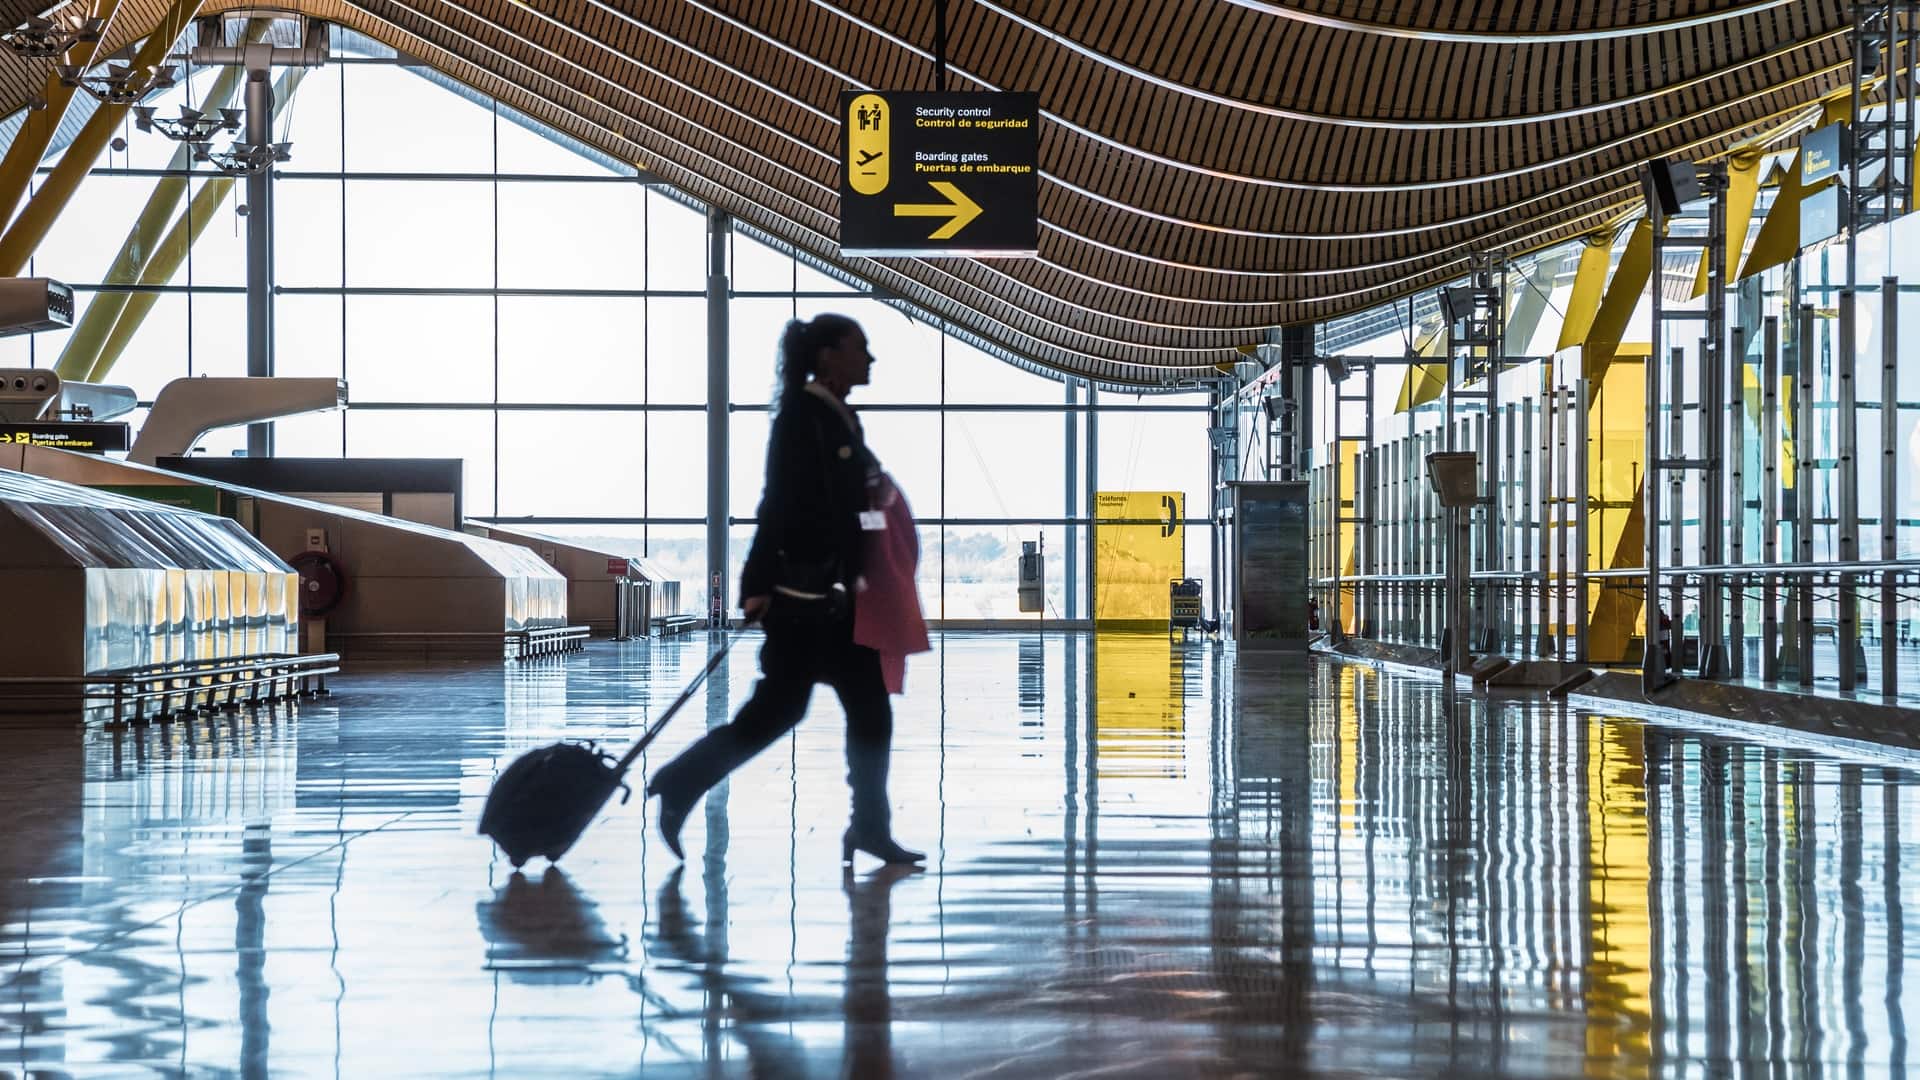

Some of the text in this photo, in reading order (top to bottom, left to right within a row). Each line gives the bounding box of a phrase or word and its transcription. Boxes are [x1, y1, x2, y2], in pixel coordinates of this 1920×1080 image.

[915, 106, 991, 118] Security control
[915, 118, 1028, 129] Control de seguridad
[915, 151, 989, 163] Boarding gates
[915, 163, 1031, 175] Puertas de embarque
